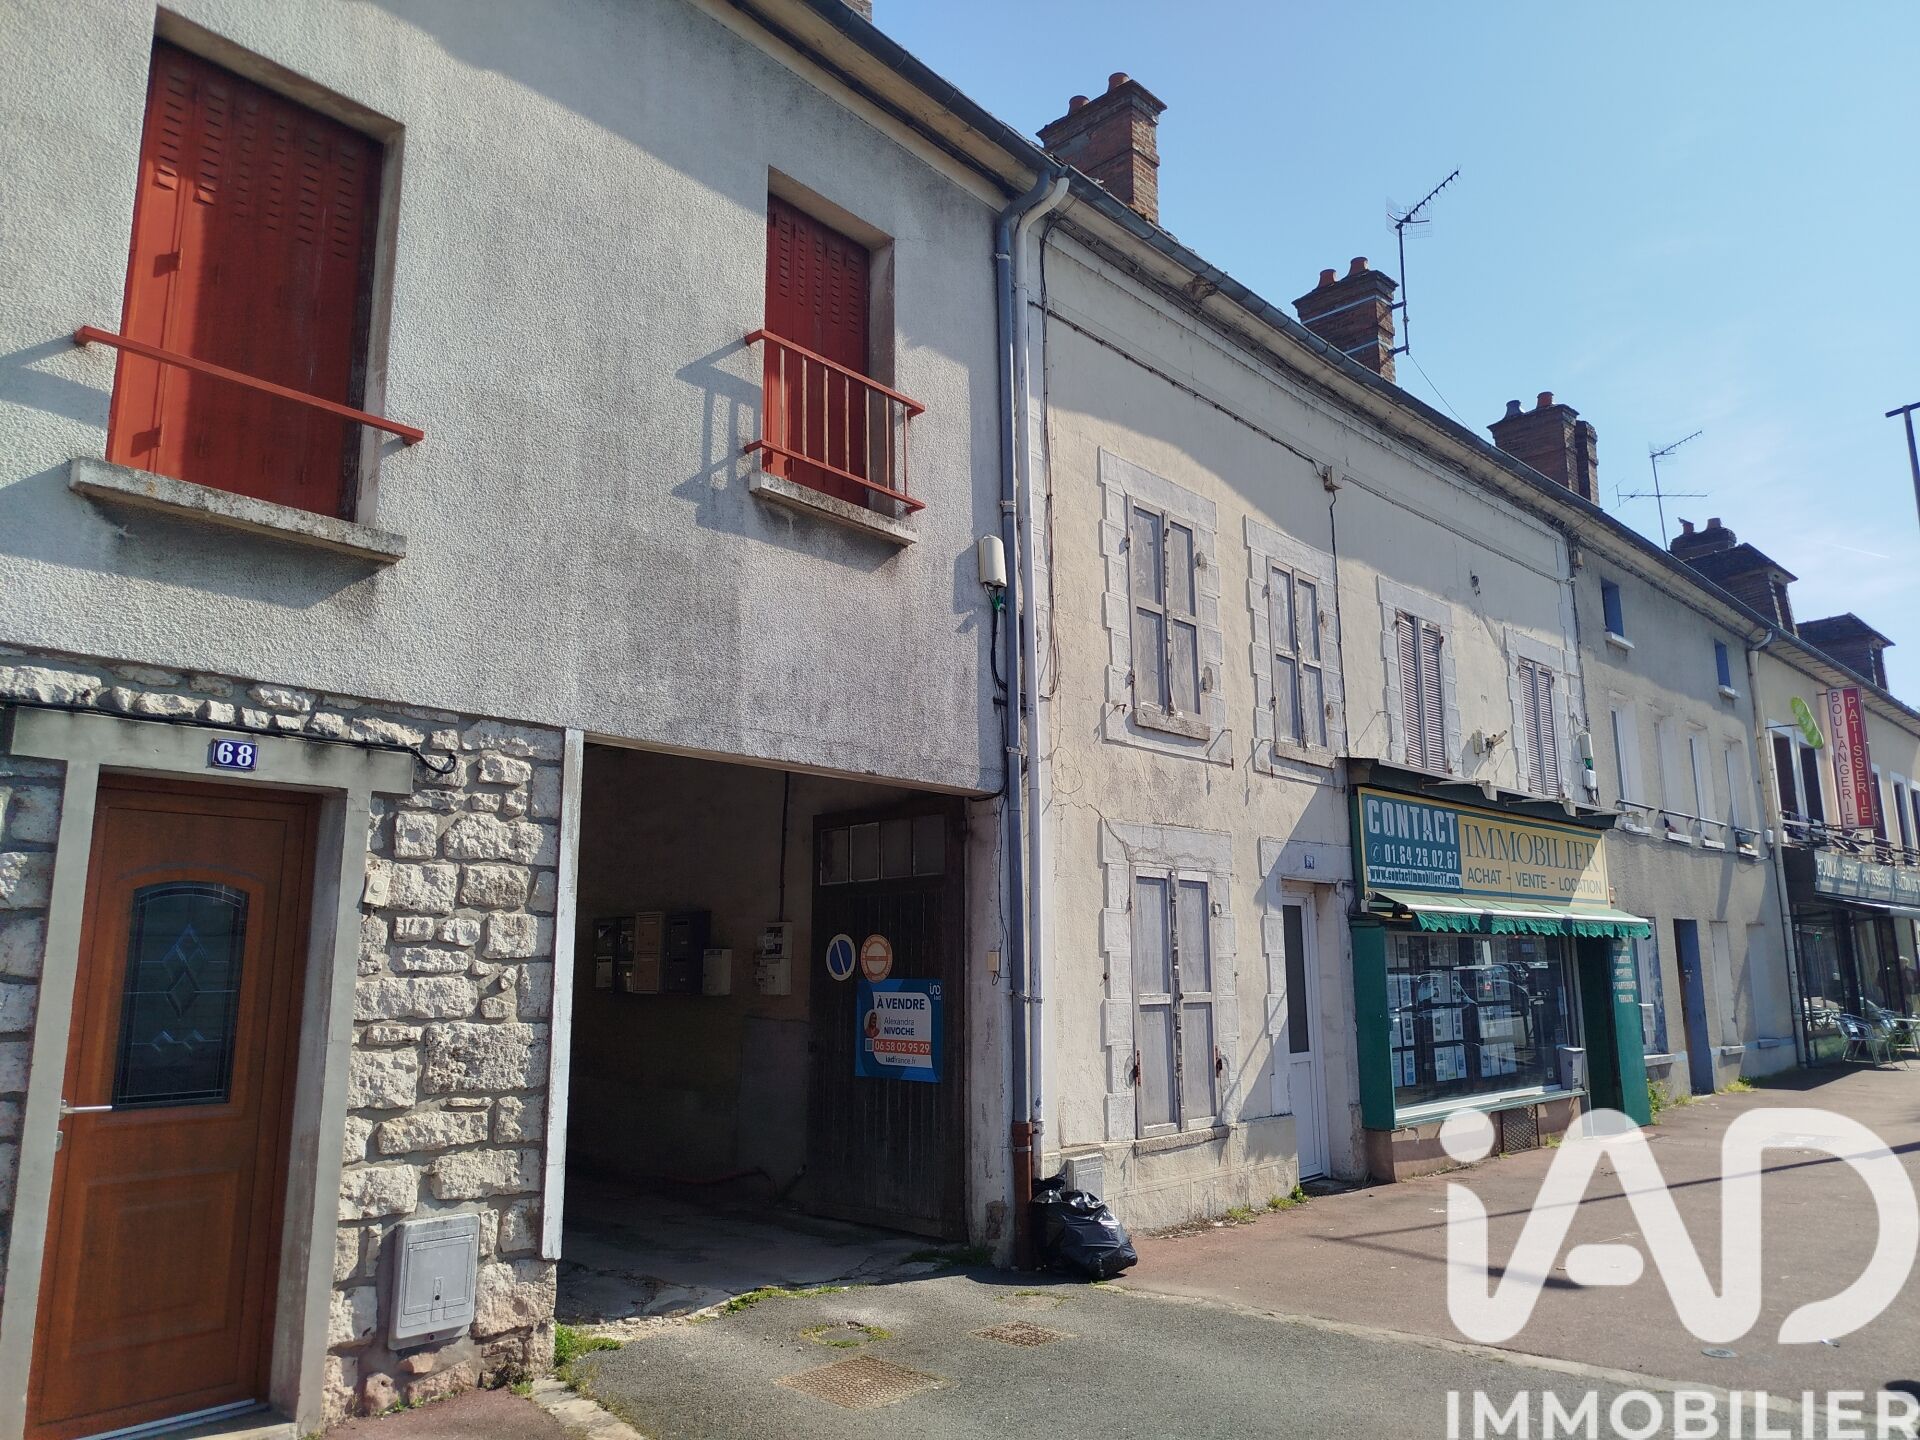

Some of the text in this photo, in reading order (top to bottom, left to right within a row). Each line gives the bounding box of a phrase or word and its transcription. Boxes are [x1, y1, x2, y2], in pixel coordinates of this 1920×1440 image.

[217, 742, 253, 767] 68
[1830, 691, 1855, 825] BOULANGERIE
[1846, 696, 1871, 819] PATISSERIE
[1367, 799, 1456, 845] CONTACT
[1384, 843, 1457, 870] 01.64.28.02.67
[1463, 823, 1600, 872] IMMOBILIER
[1467, 867, 1502, 885] ACHAT
[1515, 871, 1547, 890] VENTE
[1558, 876, 1602, 894] LOCATION
[876, 995, 926, 1010] À VENDRE
[884, 1016, 915, 1026] Alexandra
[884, 1027, 915, 1036] NIVOCHE
[875, 1041, 930, 1054] 06 58 02 95 29
